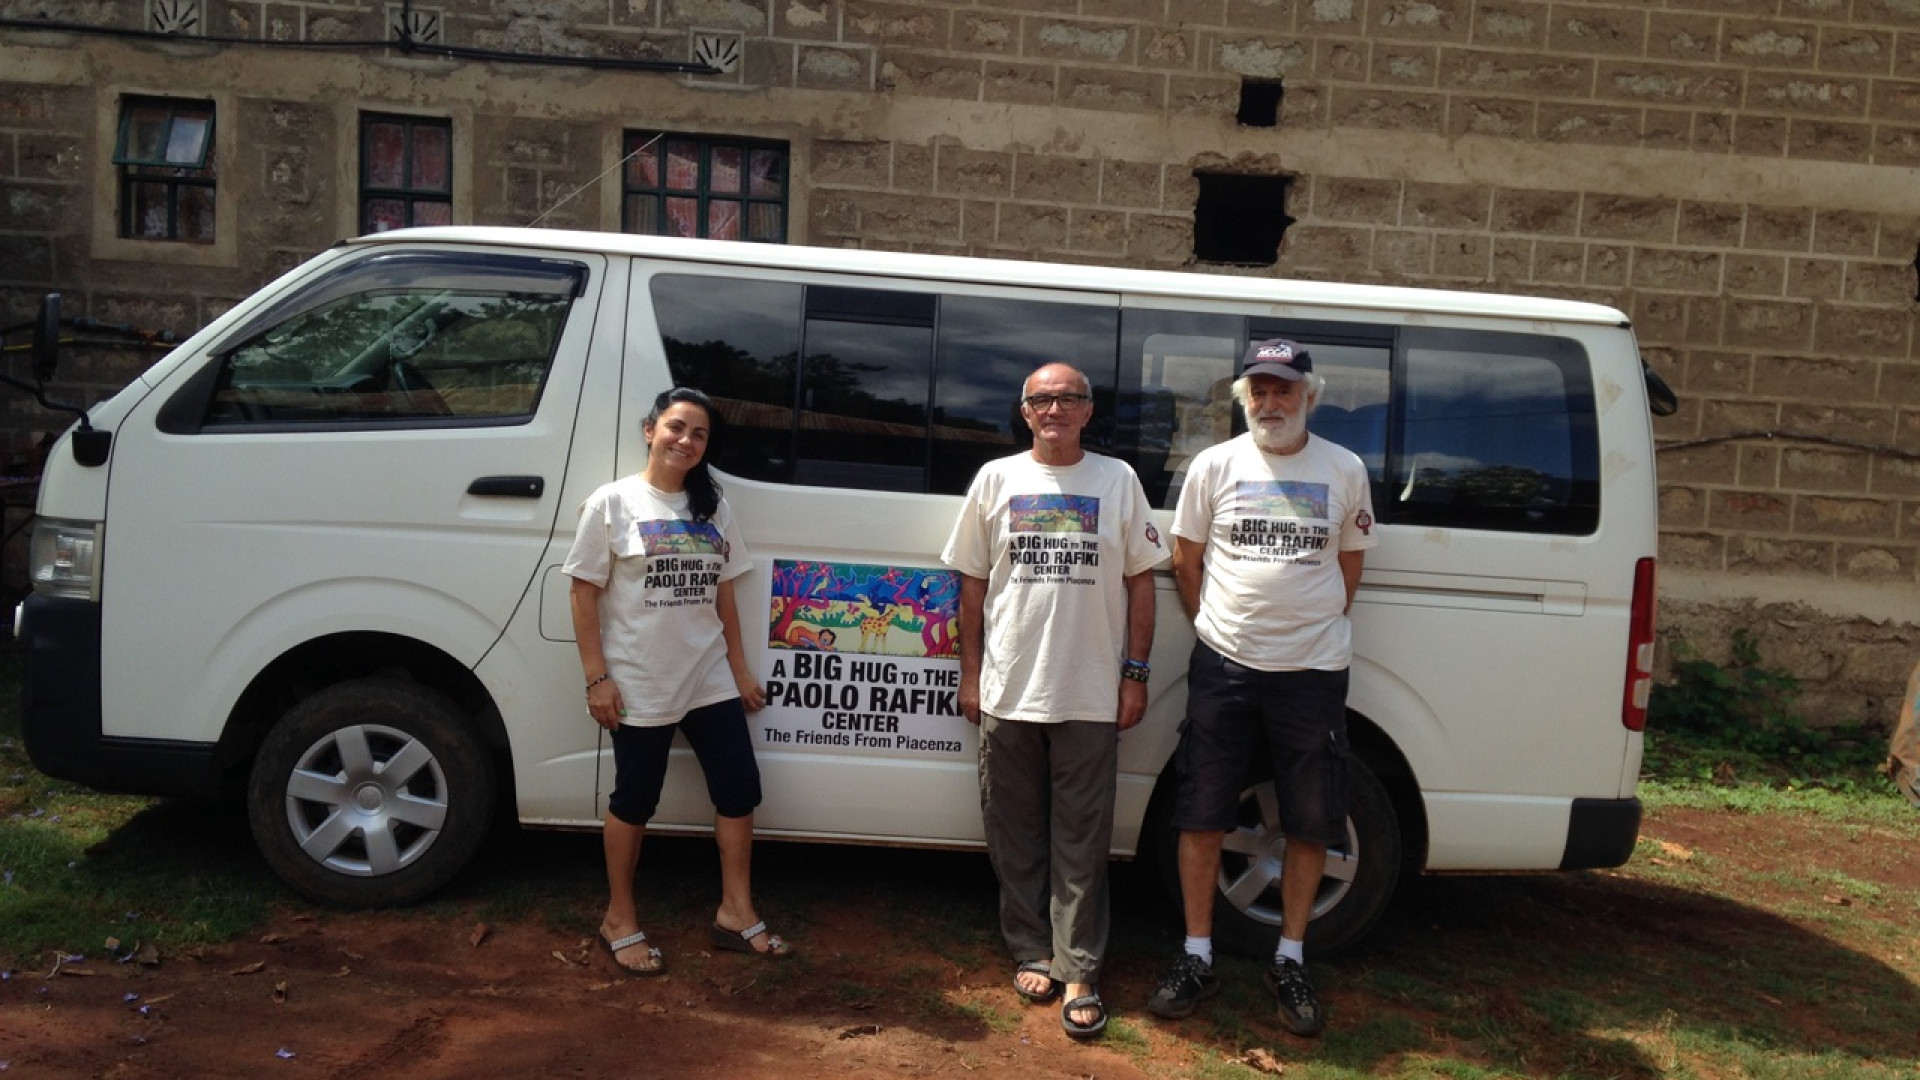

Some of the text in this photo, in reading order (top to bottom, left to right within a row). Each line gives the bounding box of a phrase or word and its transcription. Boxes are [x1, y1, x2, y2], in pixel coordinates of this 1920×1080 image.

[1231, 523, 1239, 532] A
[1242, 519, 1267, 533] BIG
[1271, 522, 1296, 534] HUG
[1312, 526, 1329, 536] THE
[1010, 541, 1016, 550] A
[1018, 536, 1041, 550] BIG
[1044, 538, 1068, 550] HUG
[1082, 541, 1099, 551] THE
[1230, 533, 1329, 549] PAOLO RAFIKI
[1259, 547, 1298, 556] CENTER
[656, 558, 679, 573] BIG
[681, 560, 703, 571] HUG
[1010, 552, 1099, 567] PAOLO RAFIKI
[1034, 565, 1070, 575] CENTER
[645, 573, 686, 588] PAOLO
[1019, 576, 1044, 584] Friends
[1047, 576, 1065, 584] From
[674, 588, 705, 598] CENTER
[645, 600, 657, 608] The
[772, 653, 959, 688] A BIG HUG TO THE
[765, 681, 859, 711] PAOLO
[822, 711, 899, 733] CENTER
[765, 729, 962, 752] The Friends From Piacenza
